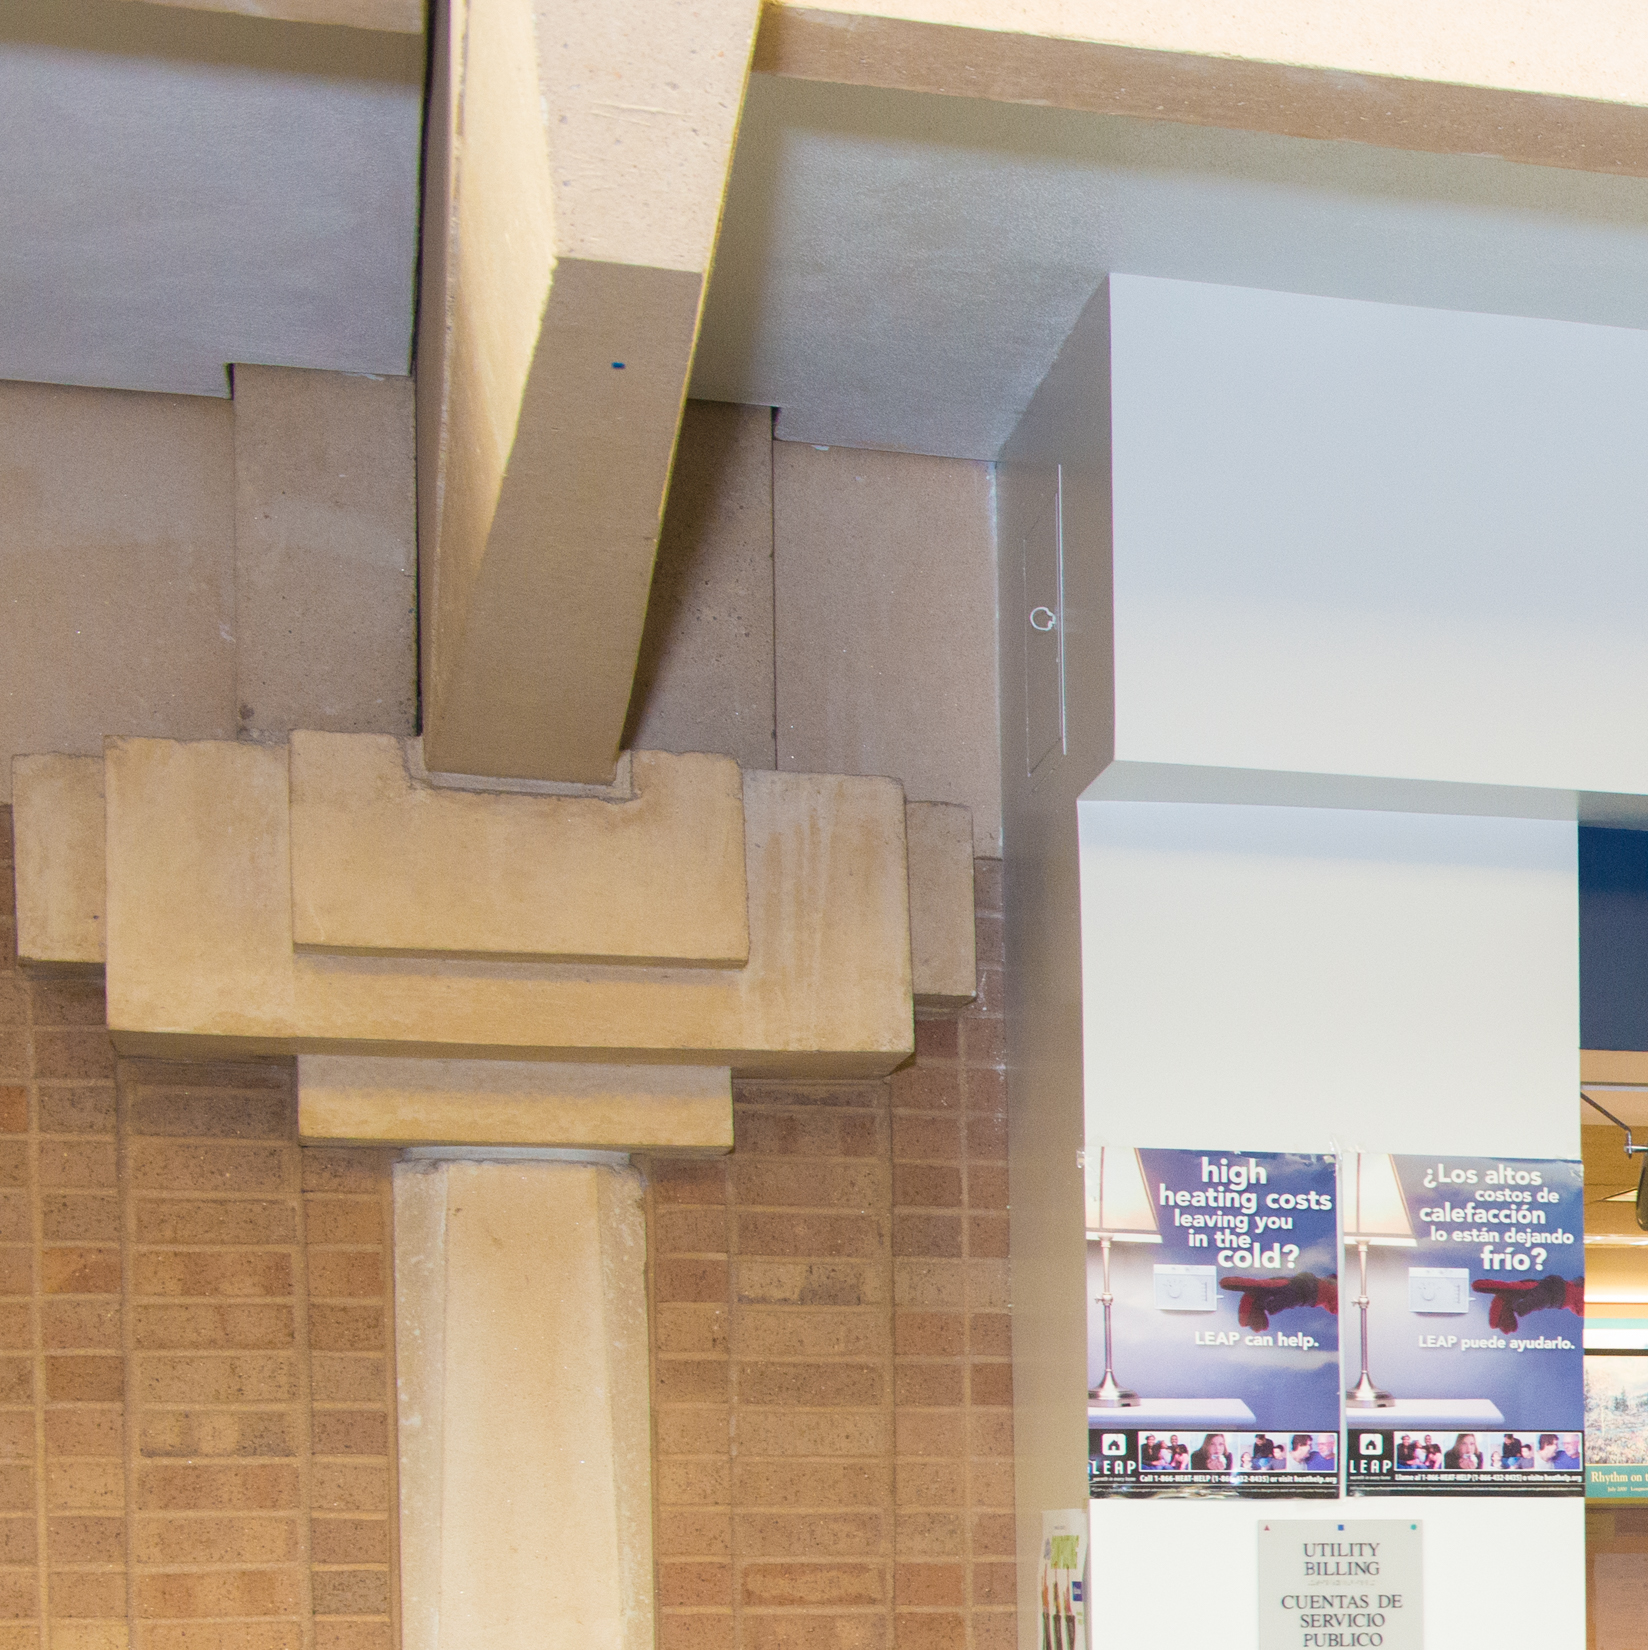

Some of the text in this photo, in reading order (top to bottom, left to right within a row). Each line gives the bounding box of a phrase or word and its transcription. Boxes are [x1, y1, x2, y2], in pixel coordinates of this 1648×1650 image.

[1202, 1156, 1267, 1191] high
[1423, 1163, 1542, 1188] ¿Los altos
[1160, 1183, 1332, 1214] heating costs
[1475, 1187, 1559, 1203] costos de
[1175, 1208, 1293, 1233] leaving you
[1420, 1202, 1546, 1224] calefacción
[1188, 1229, 1251, 1248] in the
[1430, 1226, 1574, 1247] lo están dejando
[1218, 1243, 1299, 1268] cold?
[1481, 1246, 1547, 1271] frío?
[1195, 1331, 1319, 1350] LEAP can help.
[1418, 1336, 1575, 1351] LEAP puede ayudarlo.
[1092, 1461, 1137, 1474] LEAP
[1350, 1460, 1392, 1473] LEAP
[1591, 1472, 1628, 1484] Rhythm
[1303, 1543, 1380, 1557] UTILITY
[1304, 1561, 1380, 1576] BILLING
[1281, 1594, 1403, 1609] CUENTAS DE
[1300, 1613, 1386, 1628] SERVICIO
[1303, 1633, 1383, 1648] PUBLICO
